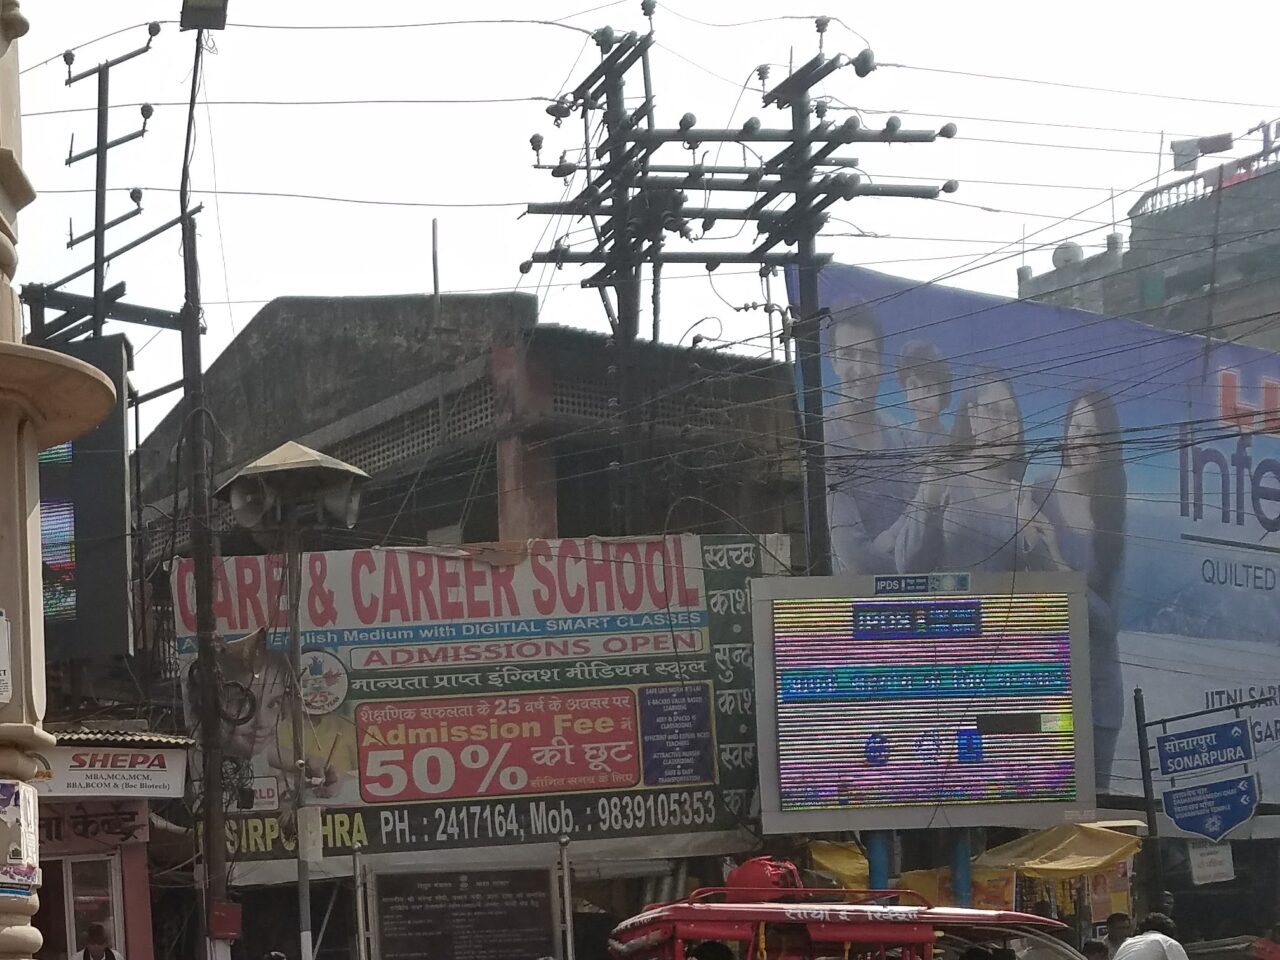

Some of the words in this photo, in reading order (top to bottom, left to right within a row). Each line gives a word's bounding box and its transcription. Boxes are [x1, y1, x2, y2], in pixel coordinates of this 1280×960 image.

[704, 543, 756, 570] स्वच्छ
[307, 552, 338, 628] &
[351, 549, 520, 625] CAREER
[529, 536, 700, 616] SCHOOL
[877, 581, 900, 590] IPDS
[1202, 559, 1276, 591] QUILTED
[343, 628, 415, 642] Medium
[419, 626, 456, 638] with
[462, 620, 541, 636] DIGITIAL
[546, 616, 610, 631] SMART
[615, 611, 701, 628] CLASSES
[363, 640, 591, 667] ADMISSIONS
[602, 632, 695, 653] OPEN
[351, 675, 429, 691] मान्यता
[434, 672, 483, 689] प्राप्त
[488, 662, 561, 687] इंग्लिश
[565, 660, 650, 680] मीडियम
[655, 659, 708, 680] स्कूल
[360, 704, 417, 724] शैक्षणिक
[420, 704, 473, 720] सफलता
[476, 699, 490, 715] के
[494, 698, 521, 715] 25
[524, 696, 546, 713] वर्ष
[548, 696, 566, 712] के
[567, 696, 610, 711] अवसर
[612, 695, 631, 708] पर
[1249, 685, 1280, 710] SAR
[362, 718, 541, 747] Admission
[553, 714, 615, 736] Fee
[1164, 732, 1217, 753] सोनारपुरा
[70, 752, 168, 769] SHEPA
[530, 736, 576, 767] की
[582, 741, 634, 772] छूट
[1167, 746, 1245, 773] SONARPURA
[84, 773, 153, 782] MBA,MCA,MCM,
[365, 742, 528, 797] 50%
[66, 782, 111, 790] BBA,BCOM
[139, 782, 171, 791] Biotech)
[380, 810, 416, 845] PH.
[434, 803, 524, 843] 2417164,
[529, 801, 580, 836] Mob.
[597, 791, 716, 832] 9839105353
